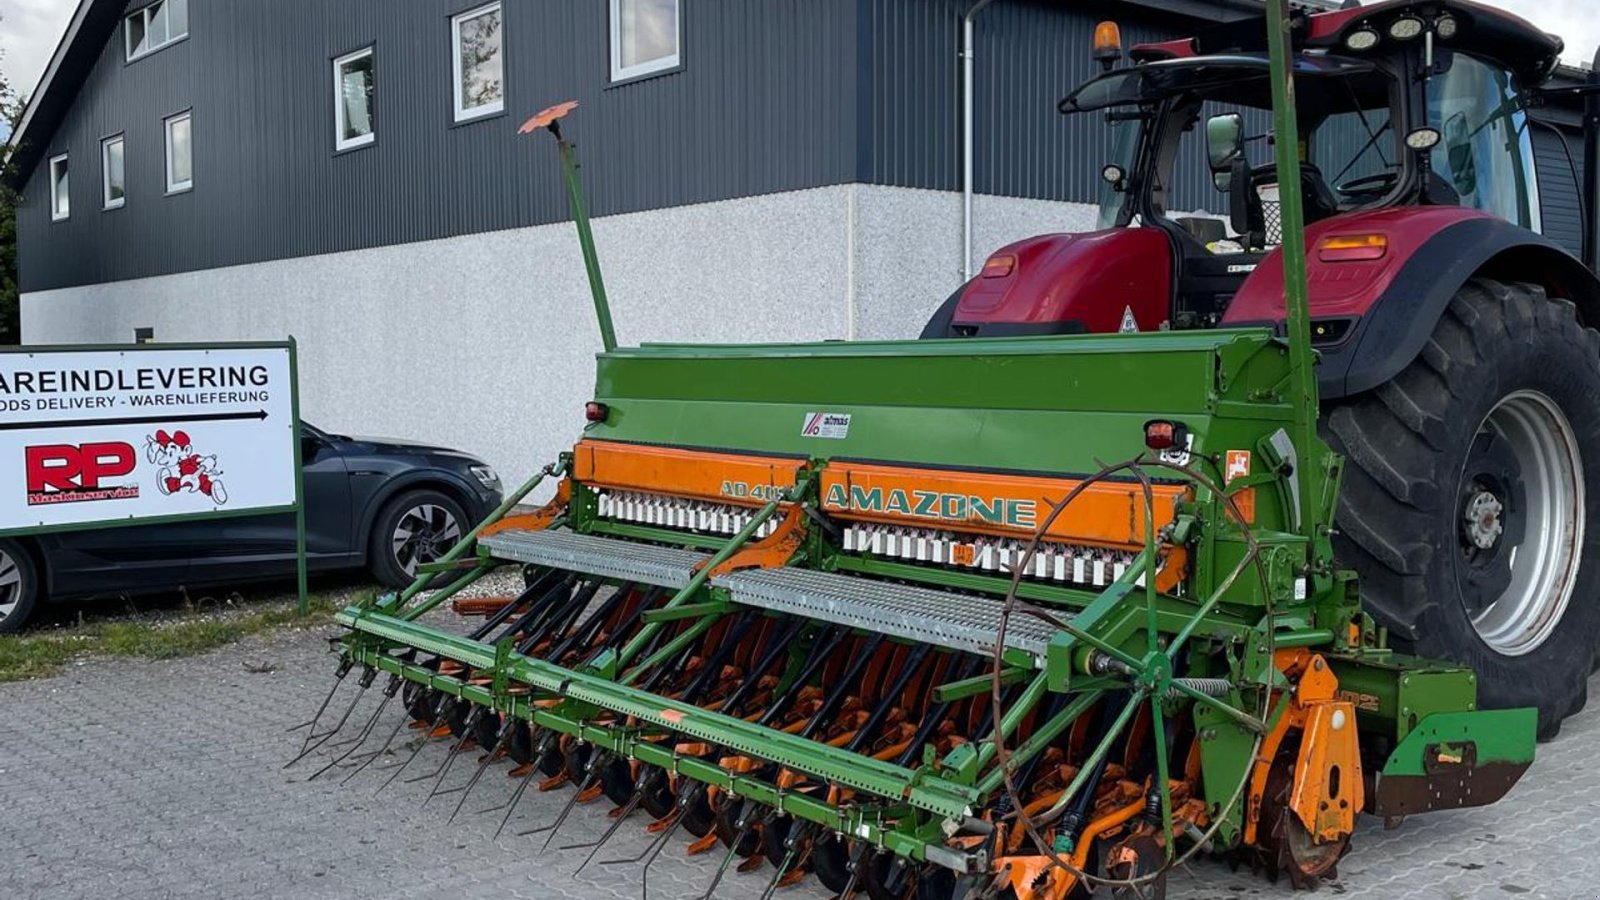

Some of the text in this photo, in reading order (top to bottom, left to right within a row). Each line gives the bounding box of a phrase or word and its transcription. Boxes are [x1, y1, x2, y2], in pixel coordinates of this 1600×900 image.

[37, 396, 116, 410] DELIVERY
[130, 391, 269, 406] WARENLIEFERUNG
[25, 441, 137, 493] RP
[824, 483, 1037, 528] AMAZONE
